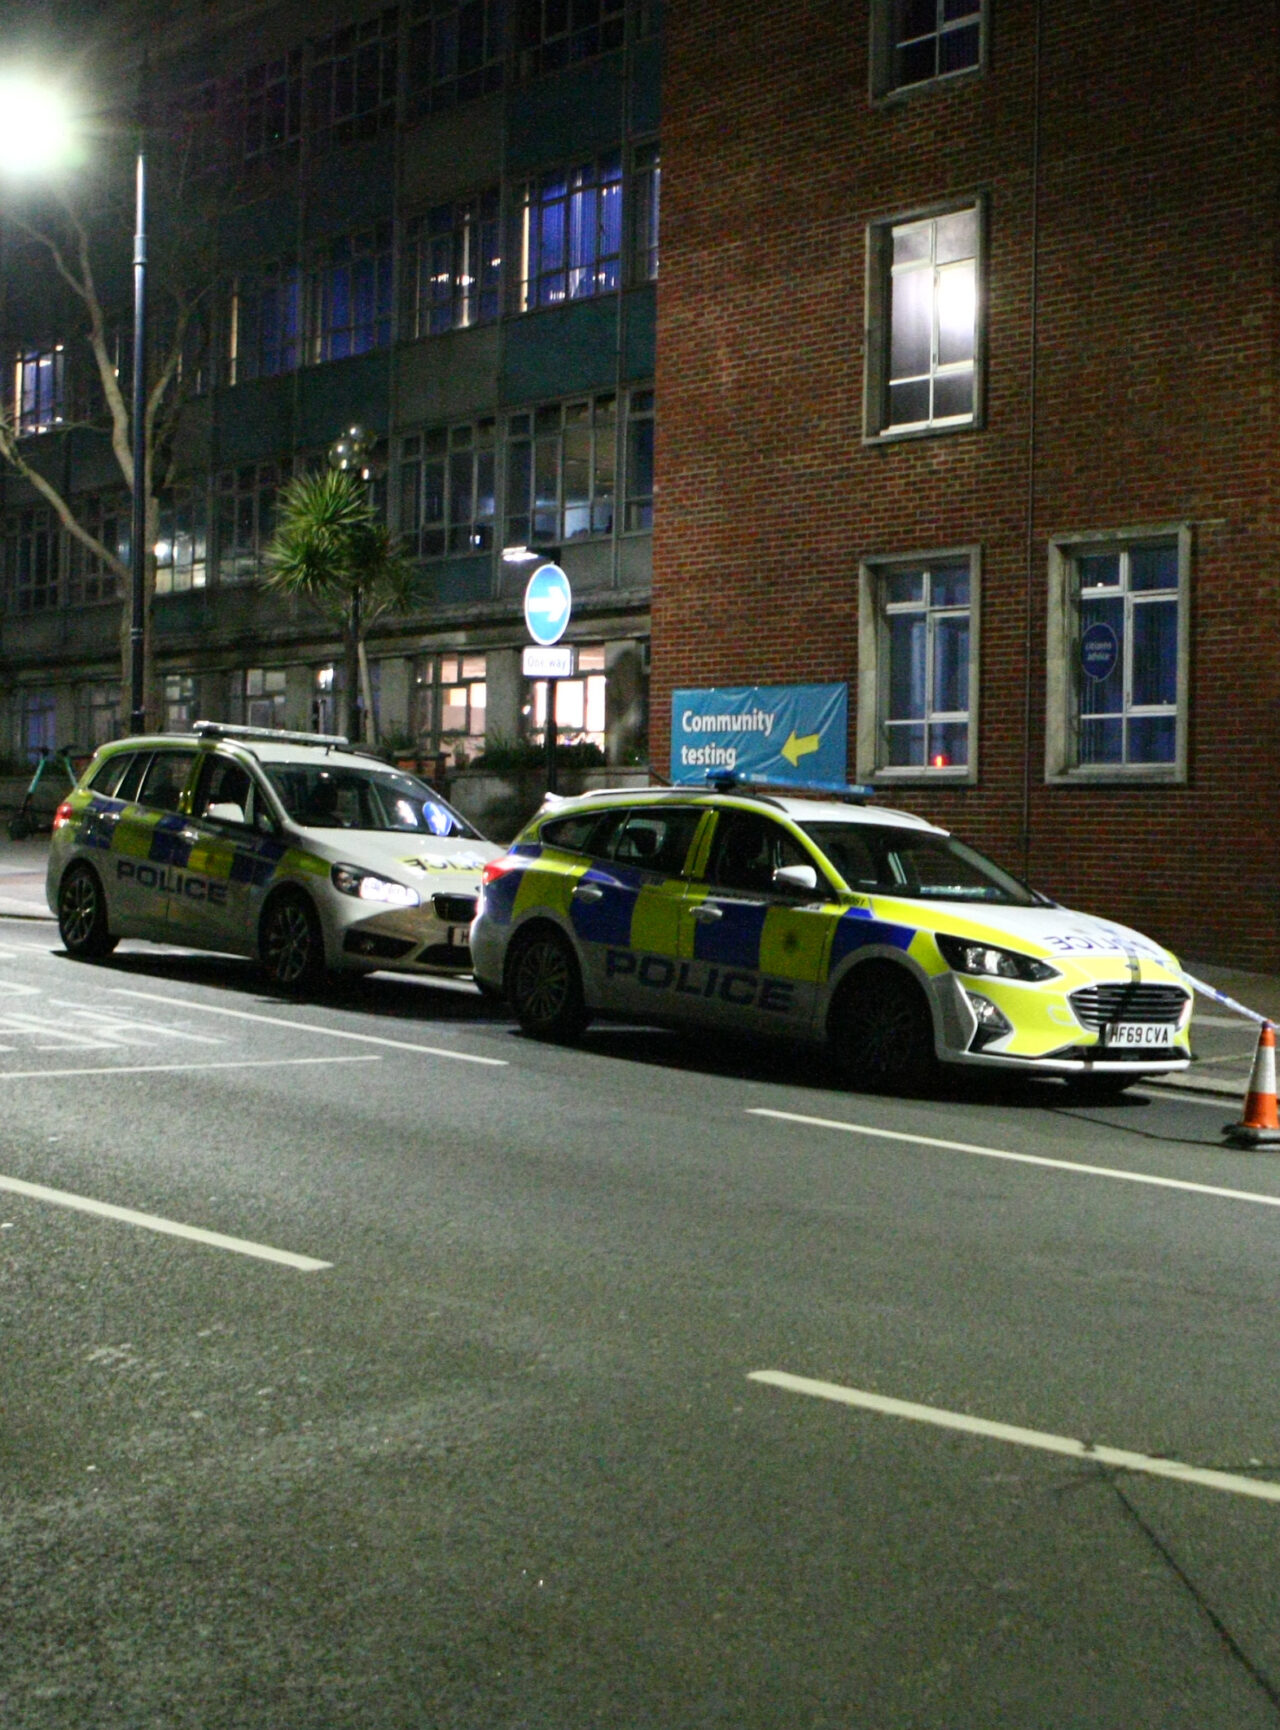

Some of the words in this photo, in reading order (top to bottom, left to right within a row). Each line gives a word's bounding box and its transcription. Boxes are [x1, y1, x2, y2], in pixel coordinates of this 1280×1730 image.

[527, 655, 544, 668] One
[549, 659, 568, 671] way
[682, 708, 774, 737] Community
[681, 744, 737, 770] testing
[117, 859, 228, 905] POLICE
[606, 949, 795, 1011] POLICE
[1110, 1026, 1143, 1043] HF69
[1145, 1027, 1168, 1043] CVA
